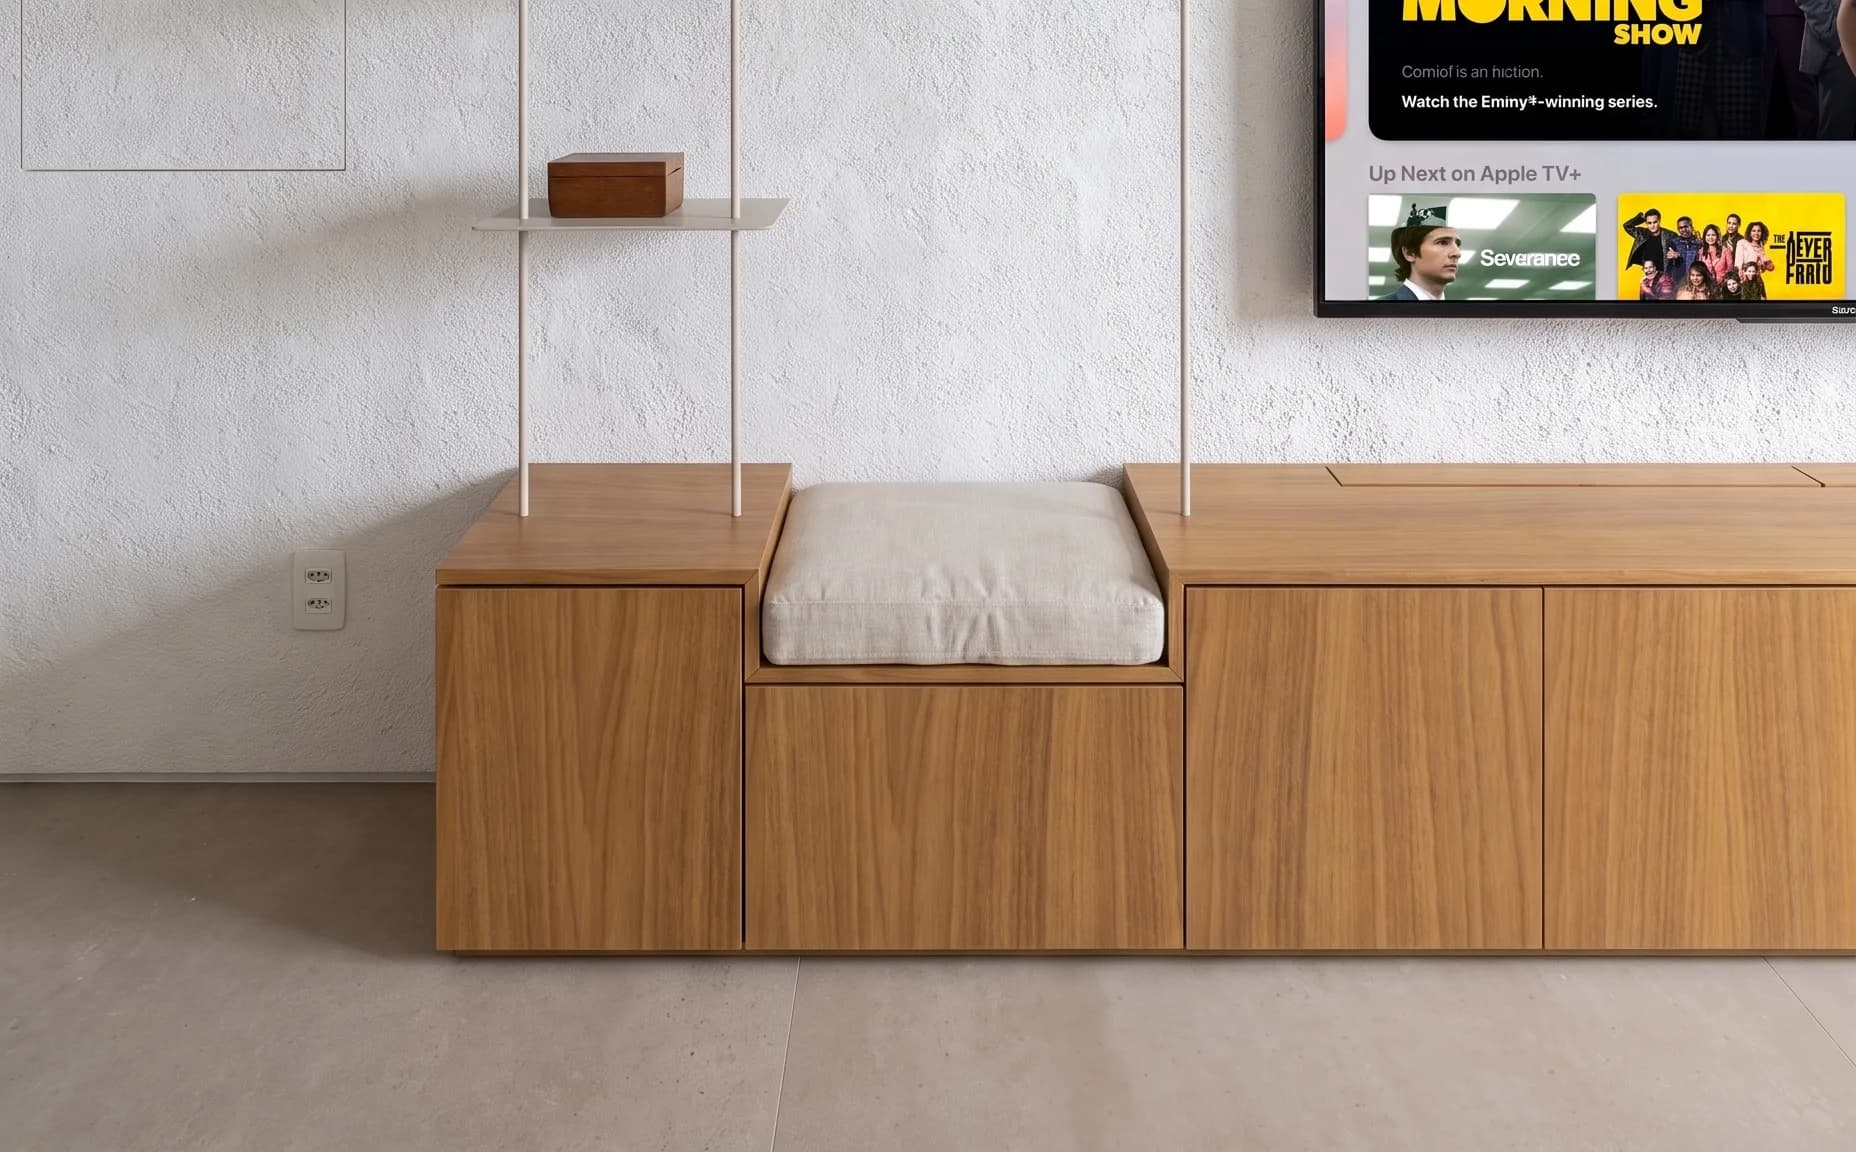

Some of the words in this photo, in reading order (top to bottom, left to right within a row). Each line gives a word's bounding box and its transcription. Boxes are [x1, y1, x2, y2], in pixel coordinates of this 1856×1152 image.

[1613, 23, 1703, 45] SHOW
[1456, 64, 1467, 79] is
[1470, 67, 1488, 79] an
[1401, 95, 1450, 109] Watch
[1453, 95, 1478, 109] the
[1607, 95, 1658, 109] series.
[1369, 165, 1396, 185] Up
[1401, 165, 1447, 182] Next
[1451, 169, 1475, 182] on
[1480, 165, 1538, 185] Apple
[1541, 165, 1582, 182] TV+
